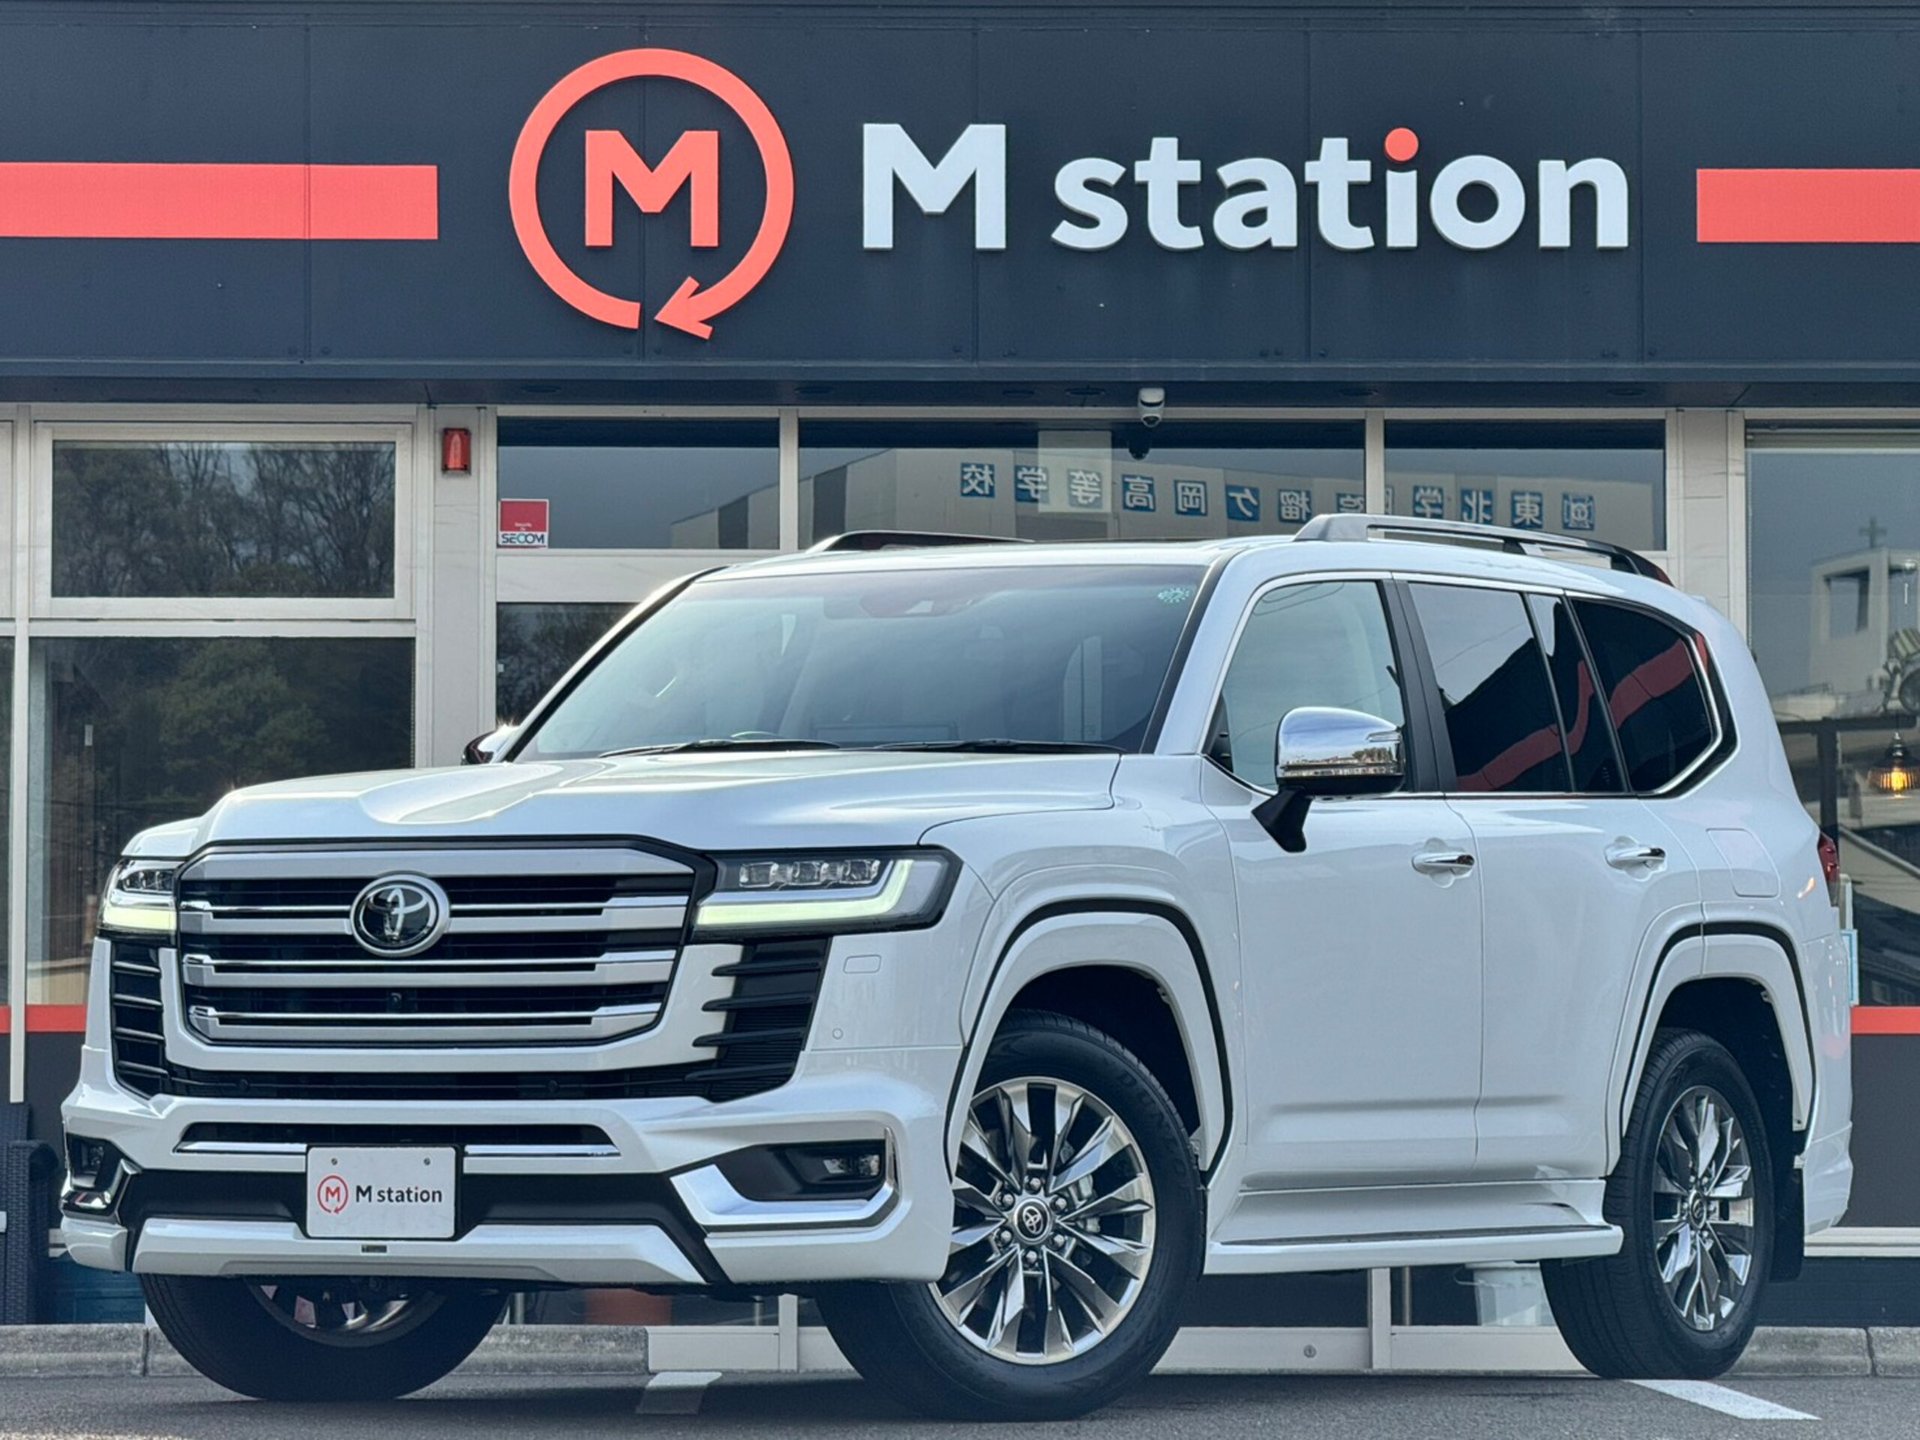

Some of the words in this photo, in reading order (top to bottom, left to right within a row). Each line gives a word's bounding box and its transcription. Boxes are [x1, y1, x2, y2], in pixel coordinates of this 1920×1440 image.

[585, 130, 719, 248] M
[862, 123, 1007, 251] M
[1050, 127, 1630, 251] station
[501, 533, 545, 544] SECOM
[325, 1186, 341, 1203] M
[356, 1185, 372, 1203] M
[377, 1186, 443, 1203] station
